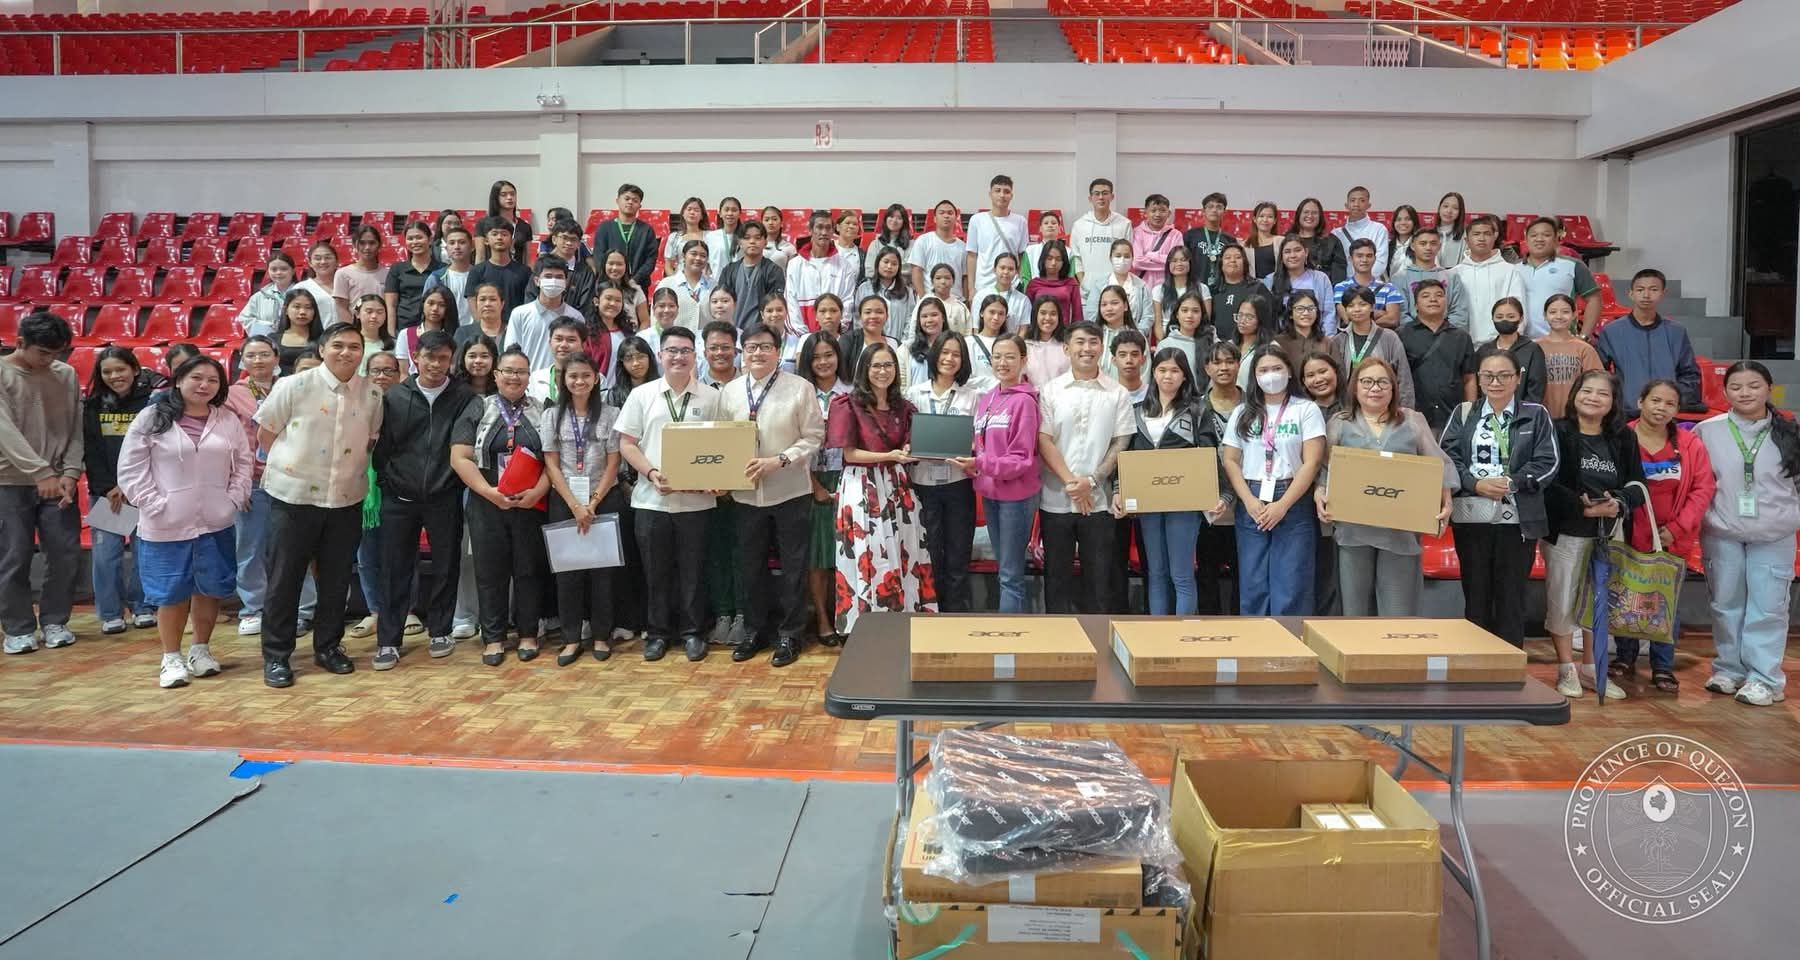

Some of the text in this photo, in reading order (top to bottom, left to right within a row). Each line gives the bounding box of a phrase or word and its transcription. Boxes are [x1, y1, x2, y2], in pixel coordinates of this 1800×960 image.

[690, 454, 724, 464] acer
[1151, 474, 1184, 486] acer
[1363, 484, 1405, 498] acer
[1180, 634, 1240, 642] acer
